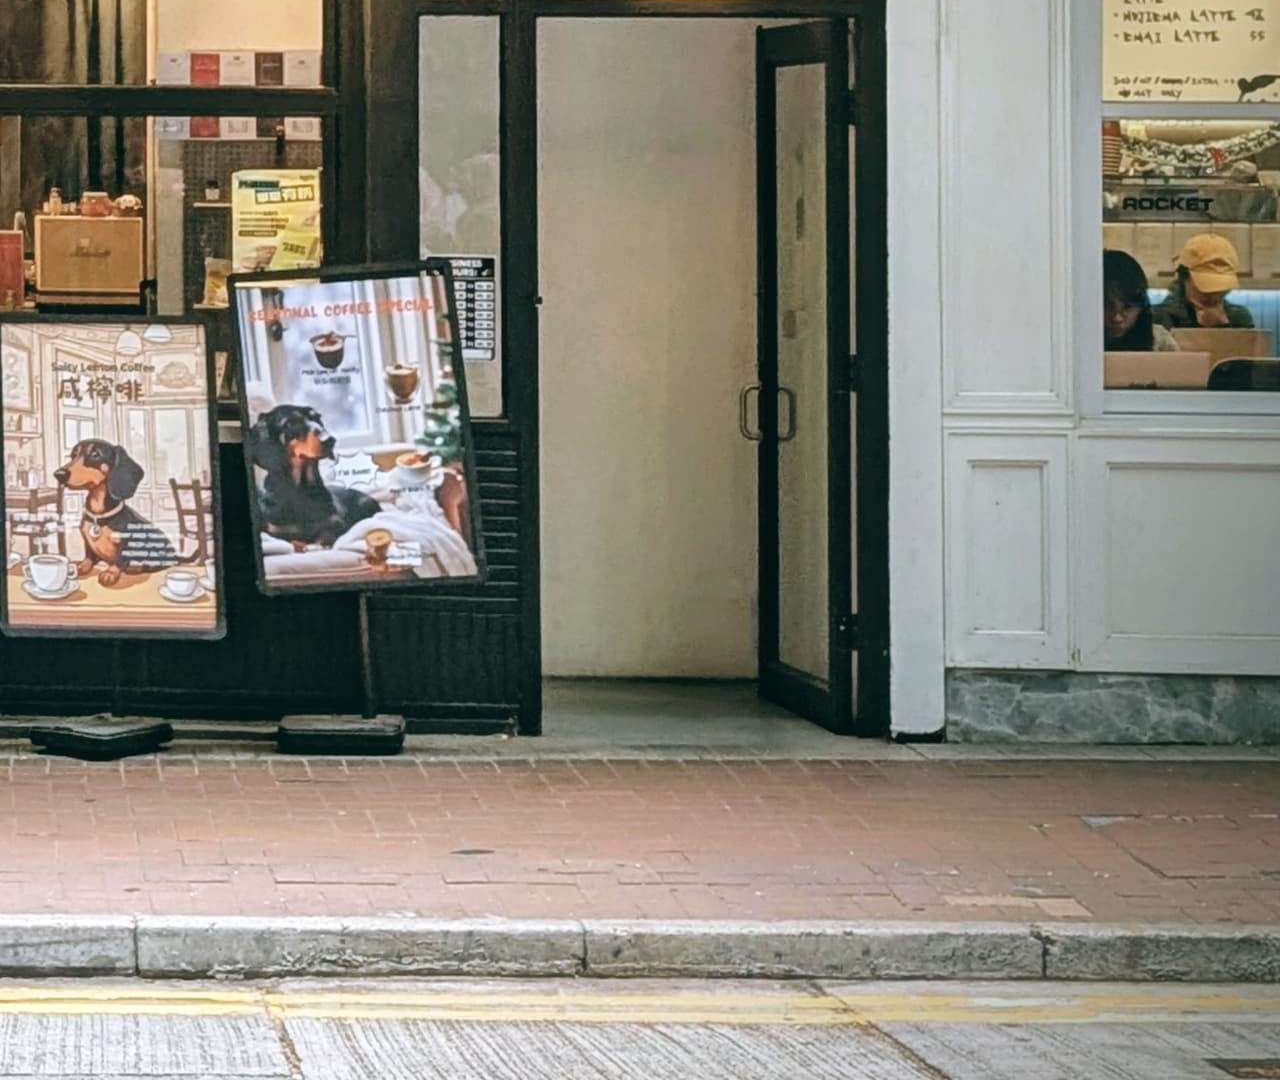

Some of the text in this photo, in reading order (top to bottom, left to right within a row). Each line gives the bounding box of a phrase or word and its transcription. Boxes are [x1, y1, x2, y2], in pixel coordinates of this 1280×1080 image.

[1191, 9, 1236, 23] LATTE
[1174, 29, 1220, 42] LATTE
[1122, 196, 1214, 213] ROCKET
[324, 302, 373, 317] COFFEE
